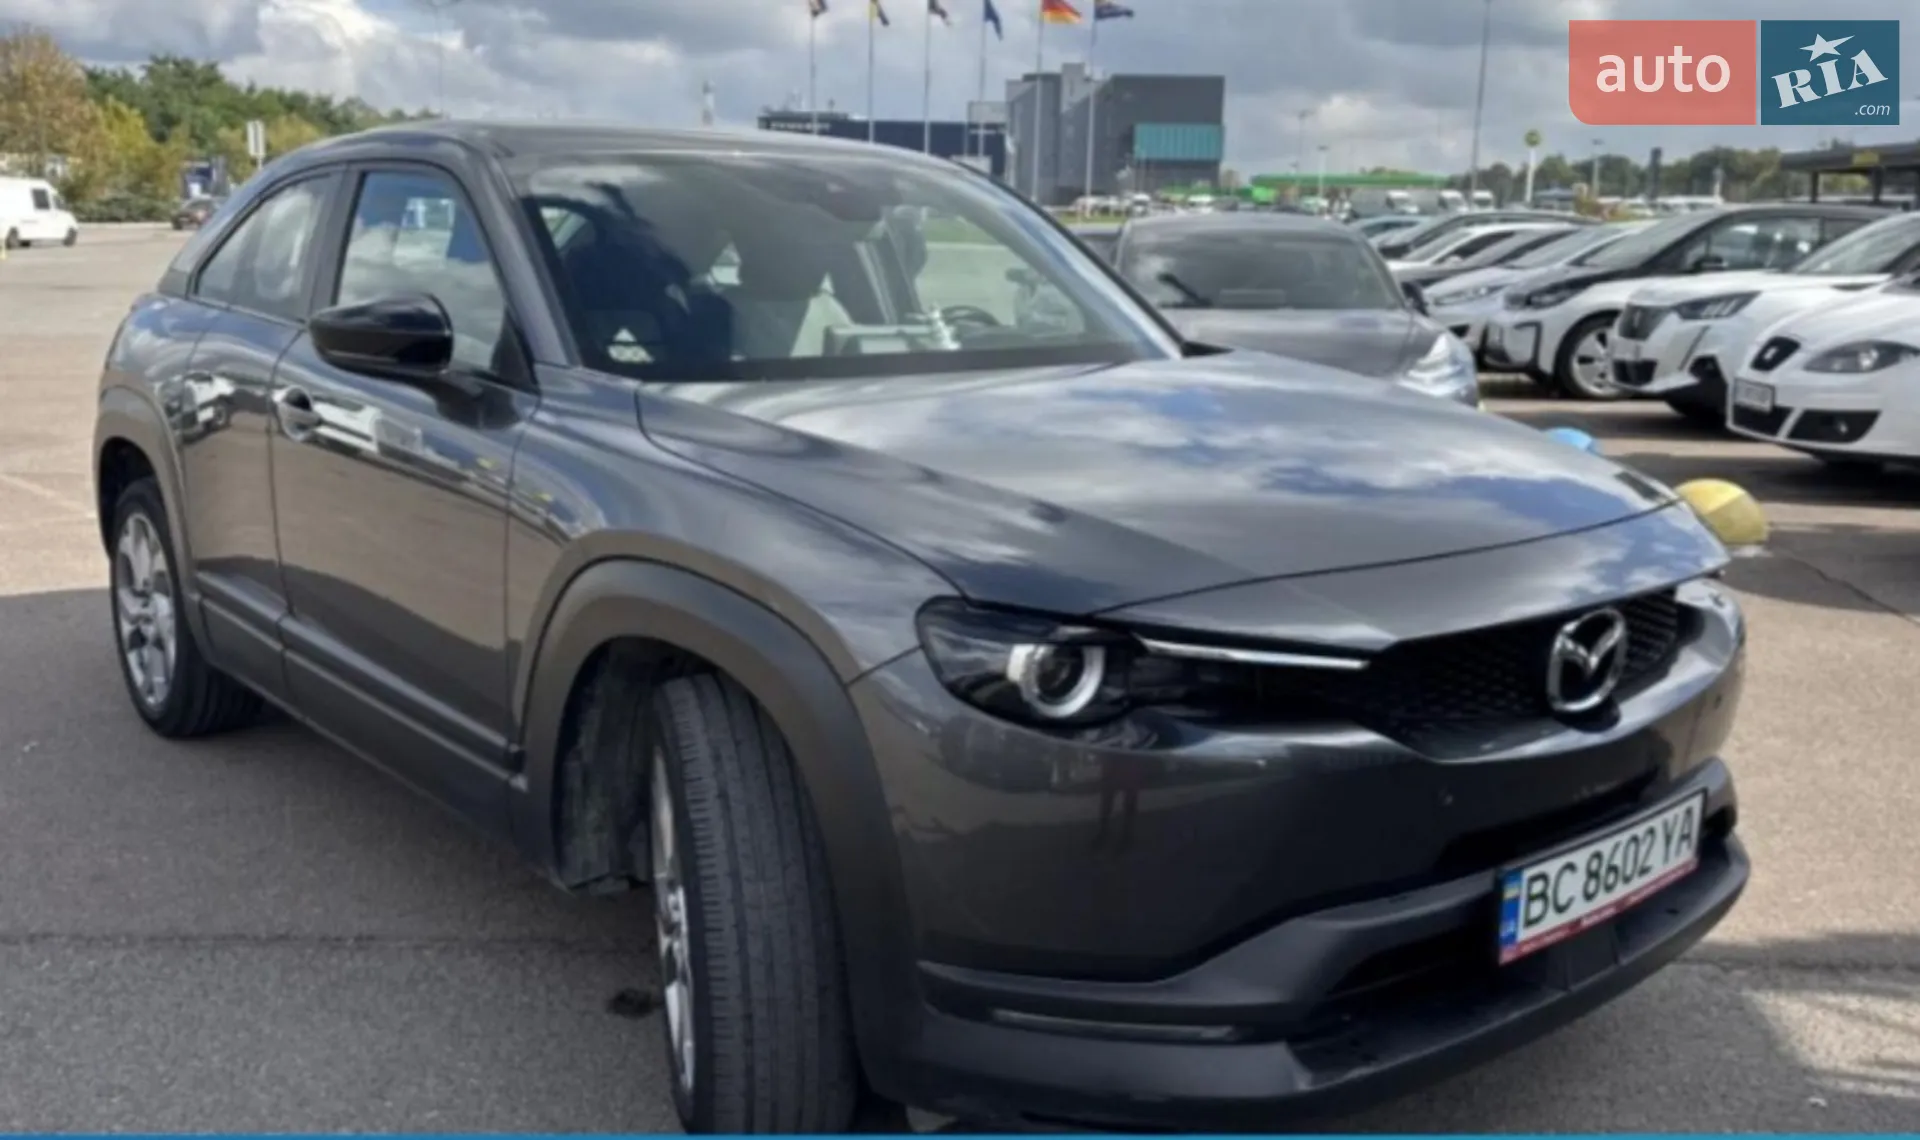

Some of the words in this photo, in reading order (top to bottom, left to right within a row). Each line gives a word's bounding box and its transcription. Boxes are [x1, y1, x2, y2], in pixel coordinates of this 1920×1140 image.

[1522, 861, 1578, 930] BC
[1582, 825, 1657, 902] 8602
[1661, 805, 1693, 865] YA
